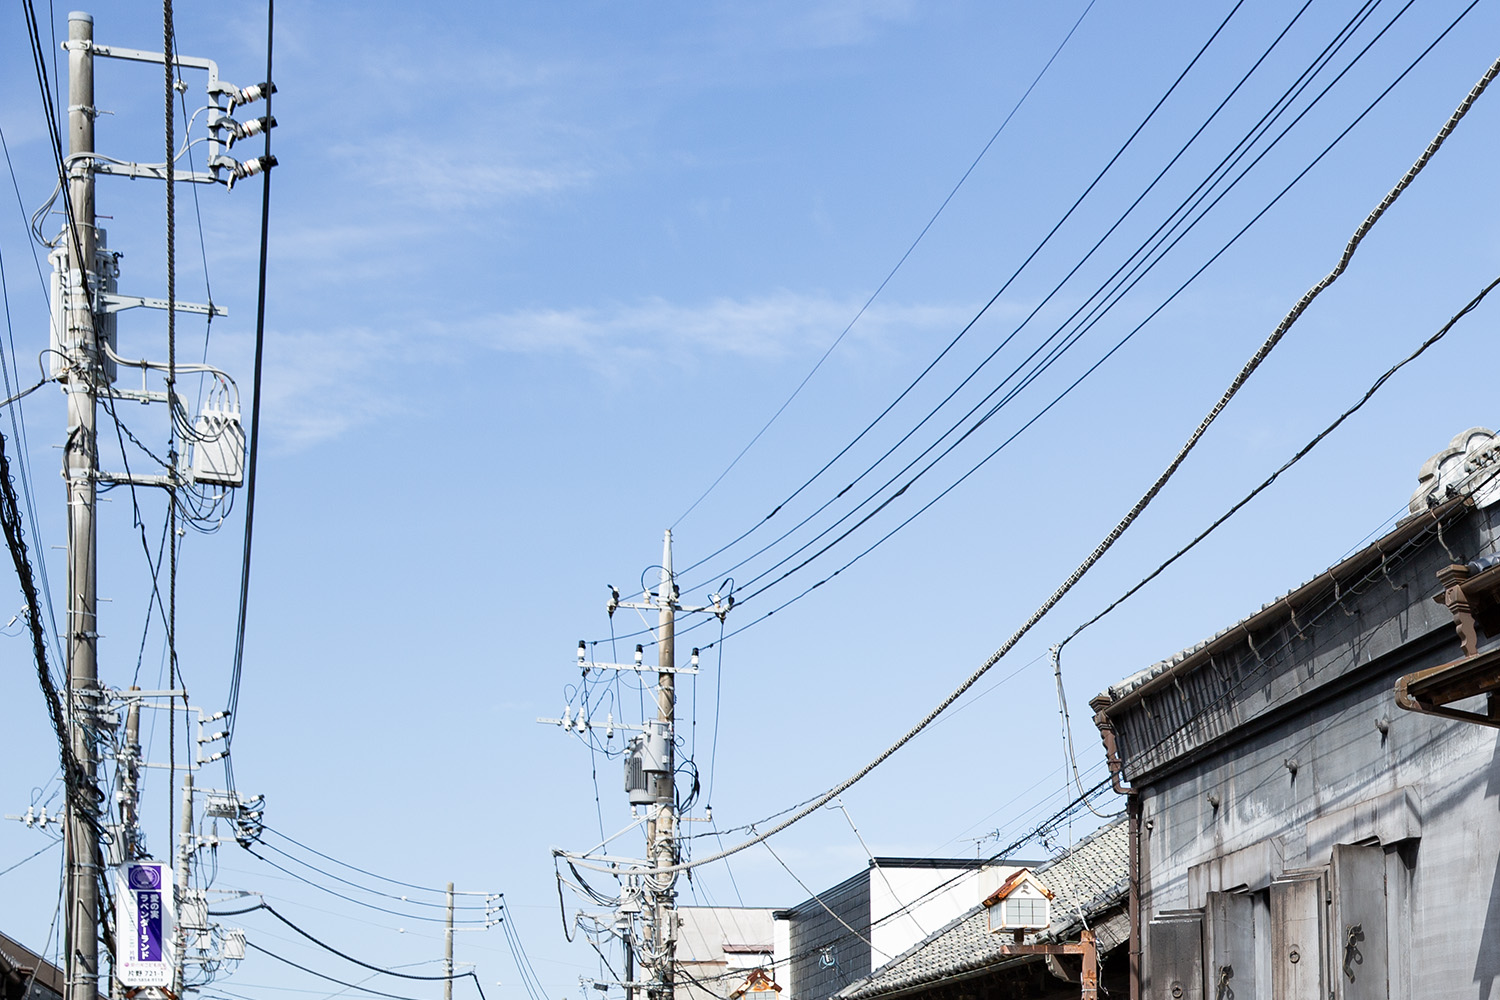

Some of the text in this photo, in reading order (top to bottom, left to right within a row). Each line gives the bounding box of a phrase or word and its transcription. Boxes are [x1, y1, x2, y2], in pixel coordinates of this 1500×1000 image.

[140, 894, 150, 960] ラベンダーランド
